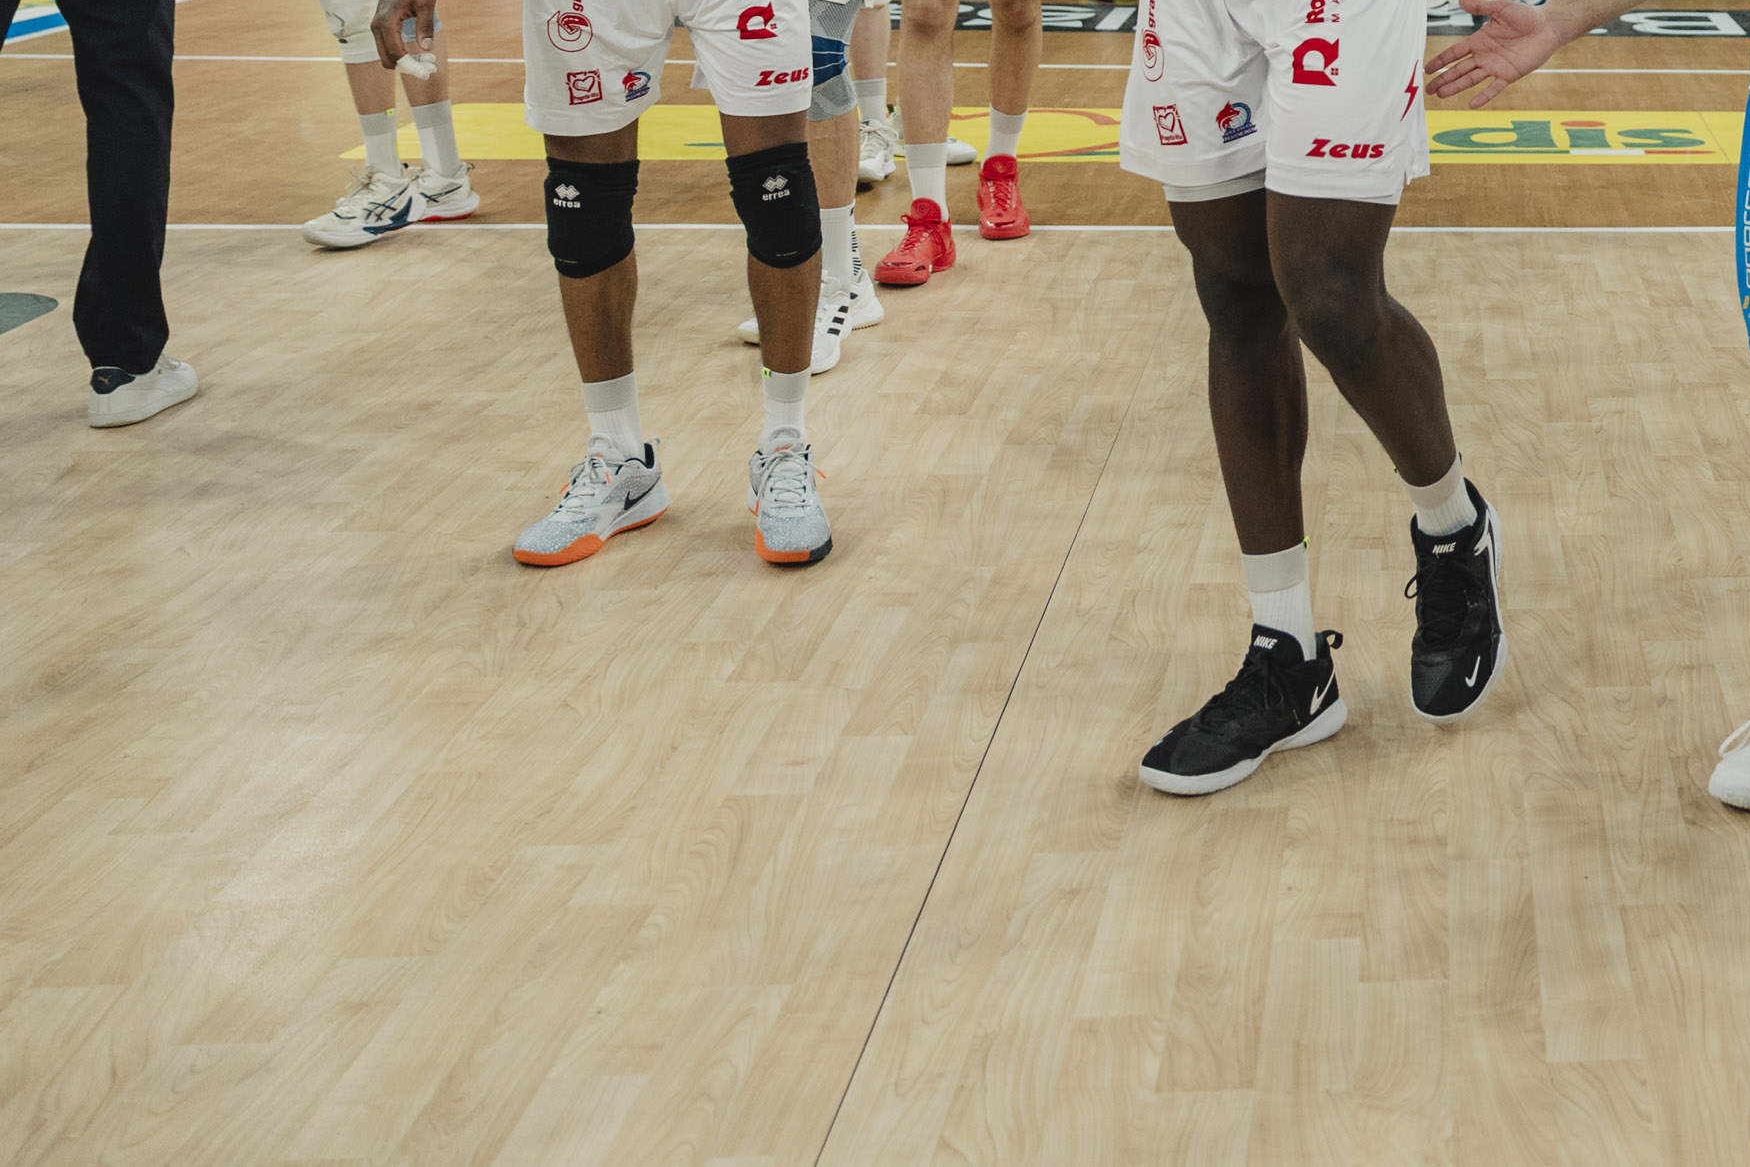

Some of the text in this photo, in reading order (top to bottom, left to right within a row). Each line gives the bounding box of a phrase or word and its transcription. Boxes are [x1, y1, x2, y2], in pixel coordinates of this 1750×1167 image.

[755, 67, 810, 87] Zeus
[1430, 119, 1707, 149] dis
[1305, 138, 1385, 159] Zeus
[553, 197, 581, 209] errea
[762, 189, 791, 201] errea
[1432, 541, 1457, 554] NIKE
[1253, 634, 1278, 650] NIKE
